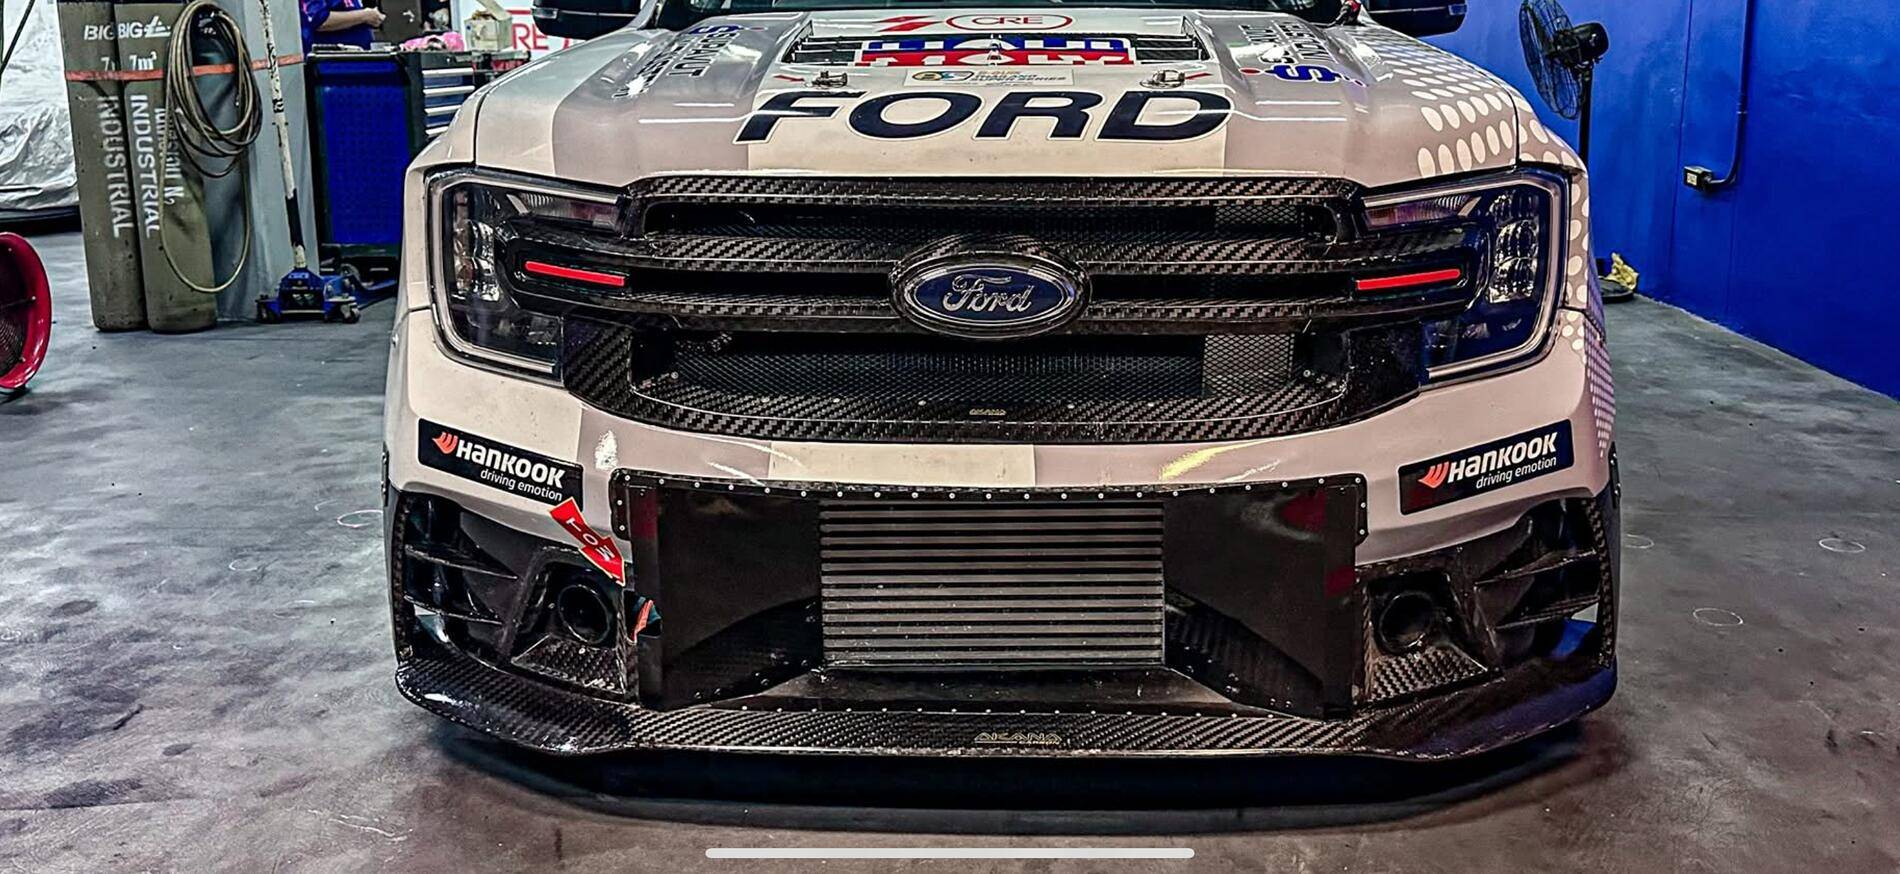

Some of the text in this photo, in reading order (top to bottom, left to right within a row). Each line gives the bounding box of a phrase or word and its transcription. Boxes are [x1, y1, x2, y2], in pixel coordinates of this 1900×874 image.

[971, 15, 1044, 25] CRE
[734, 91, 1232, 141] FORD
[97, 96, 134, 238] INDUSTRIAL
[130, 95, 161, 238] INDUSTRIAL
[943, 273, 1035, 313] Ford
[480, 468, 563, 502] driving emotion
[1476, 456, 1557, 490] driving emotion
[565, 516, 616, 562] TOW
